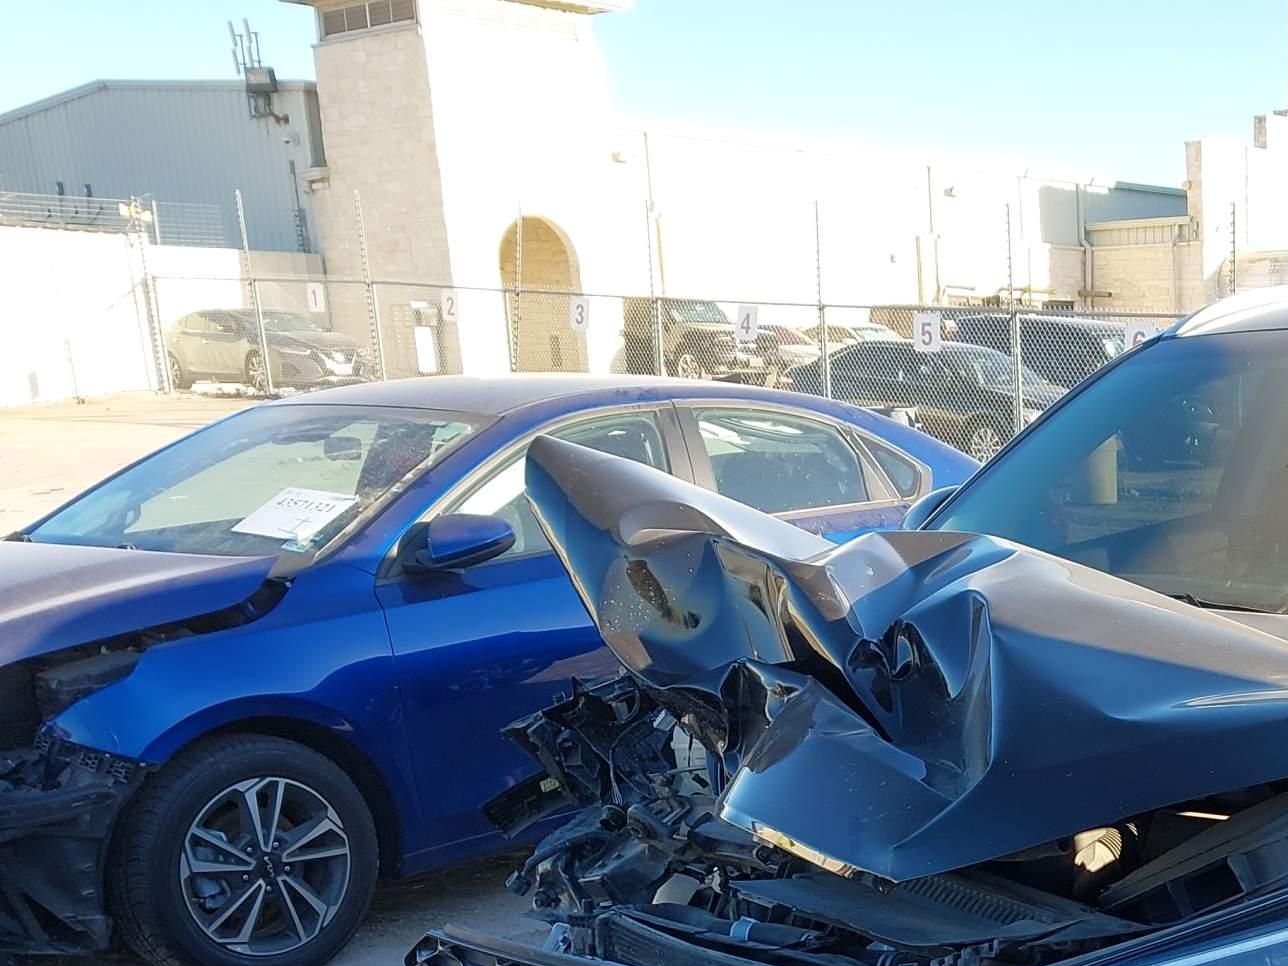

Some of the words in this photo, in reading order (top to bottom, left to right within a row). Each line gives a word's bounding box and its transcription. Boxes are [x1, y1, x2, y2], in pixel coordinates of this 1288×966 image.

[446, 297, 455, 316] 2
[575, 303, 584, 324] 3
[740, 313, 751, 334] 4
[921, 321, 933, 346] 5
